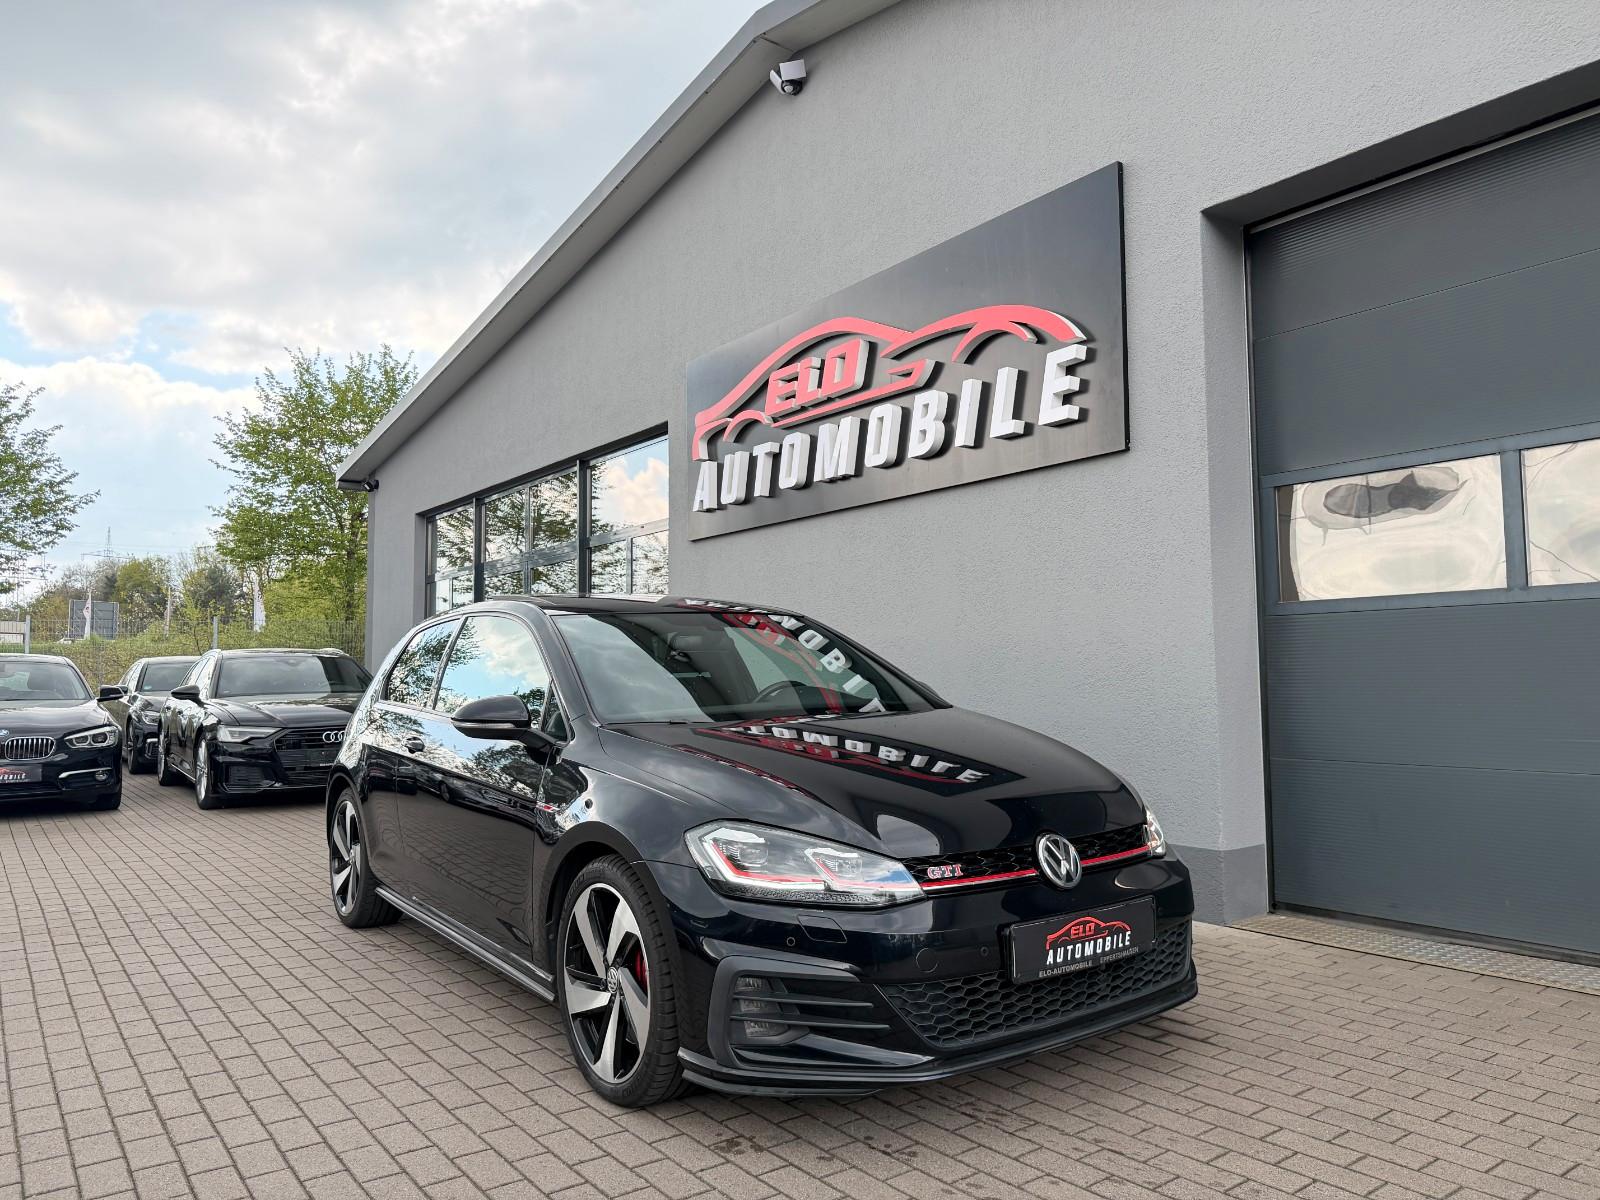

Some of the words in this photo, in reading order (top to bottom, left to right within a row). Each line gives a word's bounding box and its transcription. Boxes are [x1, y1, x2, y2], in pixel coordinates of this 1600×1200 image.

[765, 338, 869, 418] ELO
[692, 343, 1088, 513] AUTOMOBILE
[927, 864, 963, 879] GTI
[1070, 922, 1096, 939] ELO
[1046, 931, 1132, 966] AUTOMOBILE
[1038, 960, 1093, 978] ELO-AUTOMOBILE
